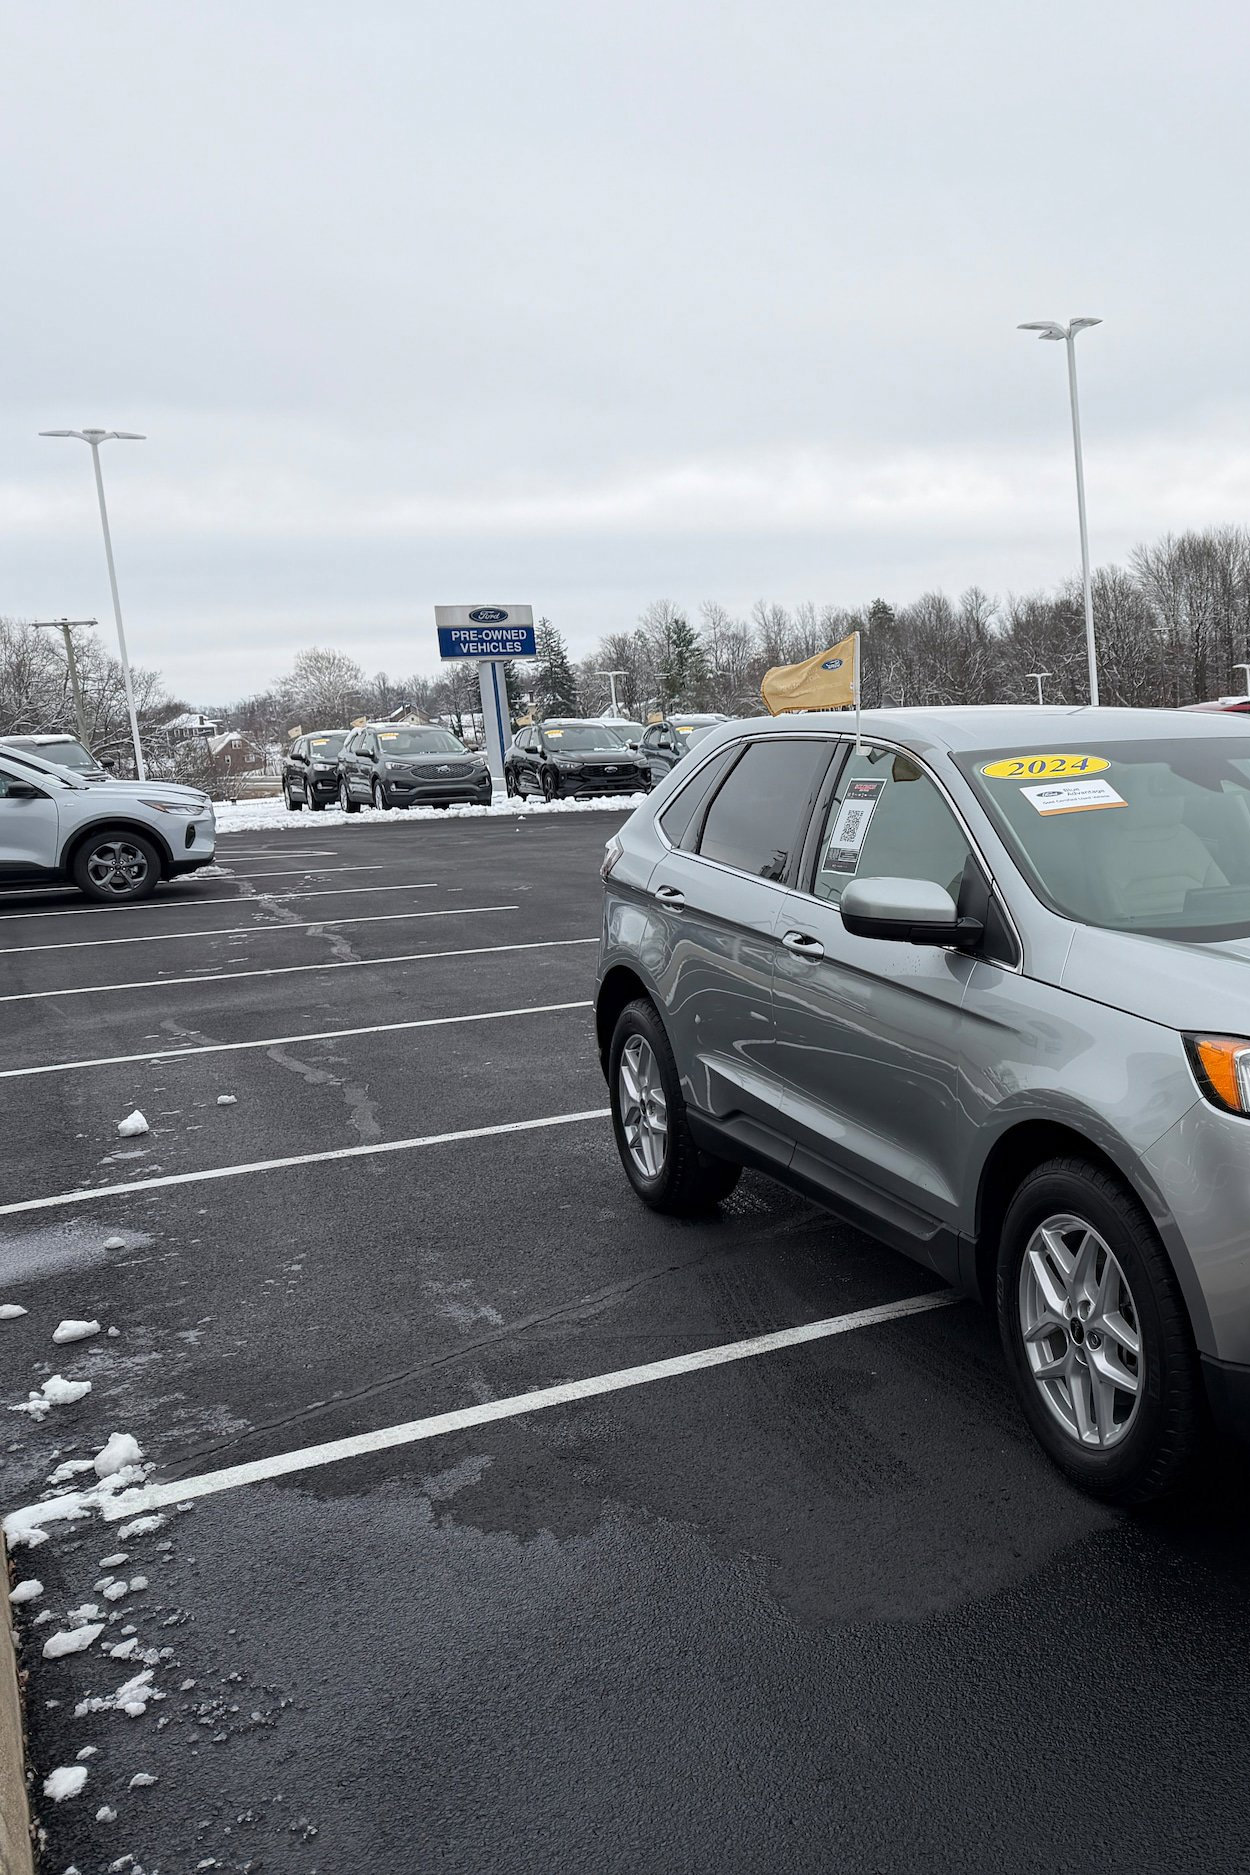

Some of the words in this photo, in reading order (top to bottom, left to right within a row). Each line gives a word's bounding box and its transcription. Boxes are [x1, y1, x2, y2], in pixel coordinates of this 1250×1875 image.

[478, 611, 500, 619] Ford
[452, 630, 527, 641] PRE-OWNED
[460, 642, 522, 653] VEHICLES
[1008, 758, 1089, 776] 2024
